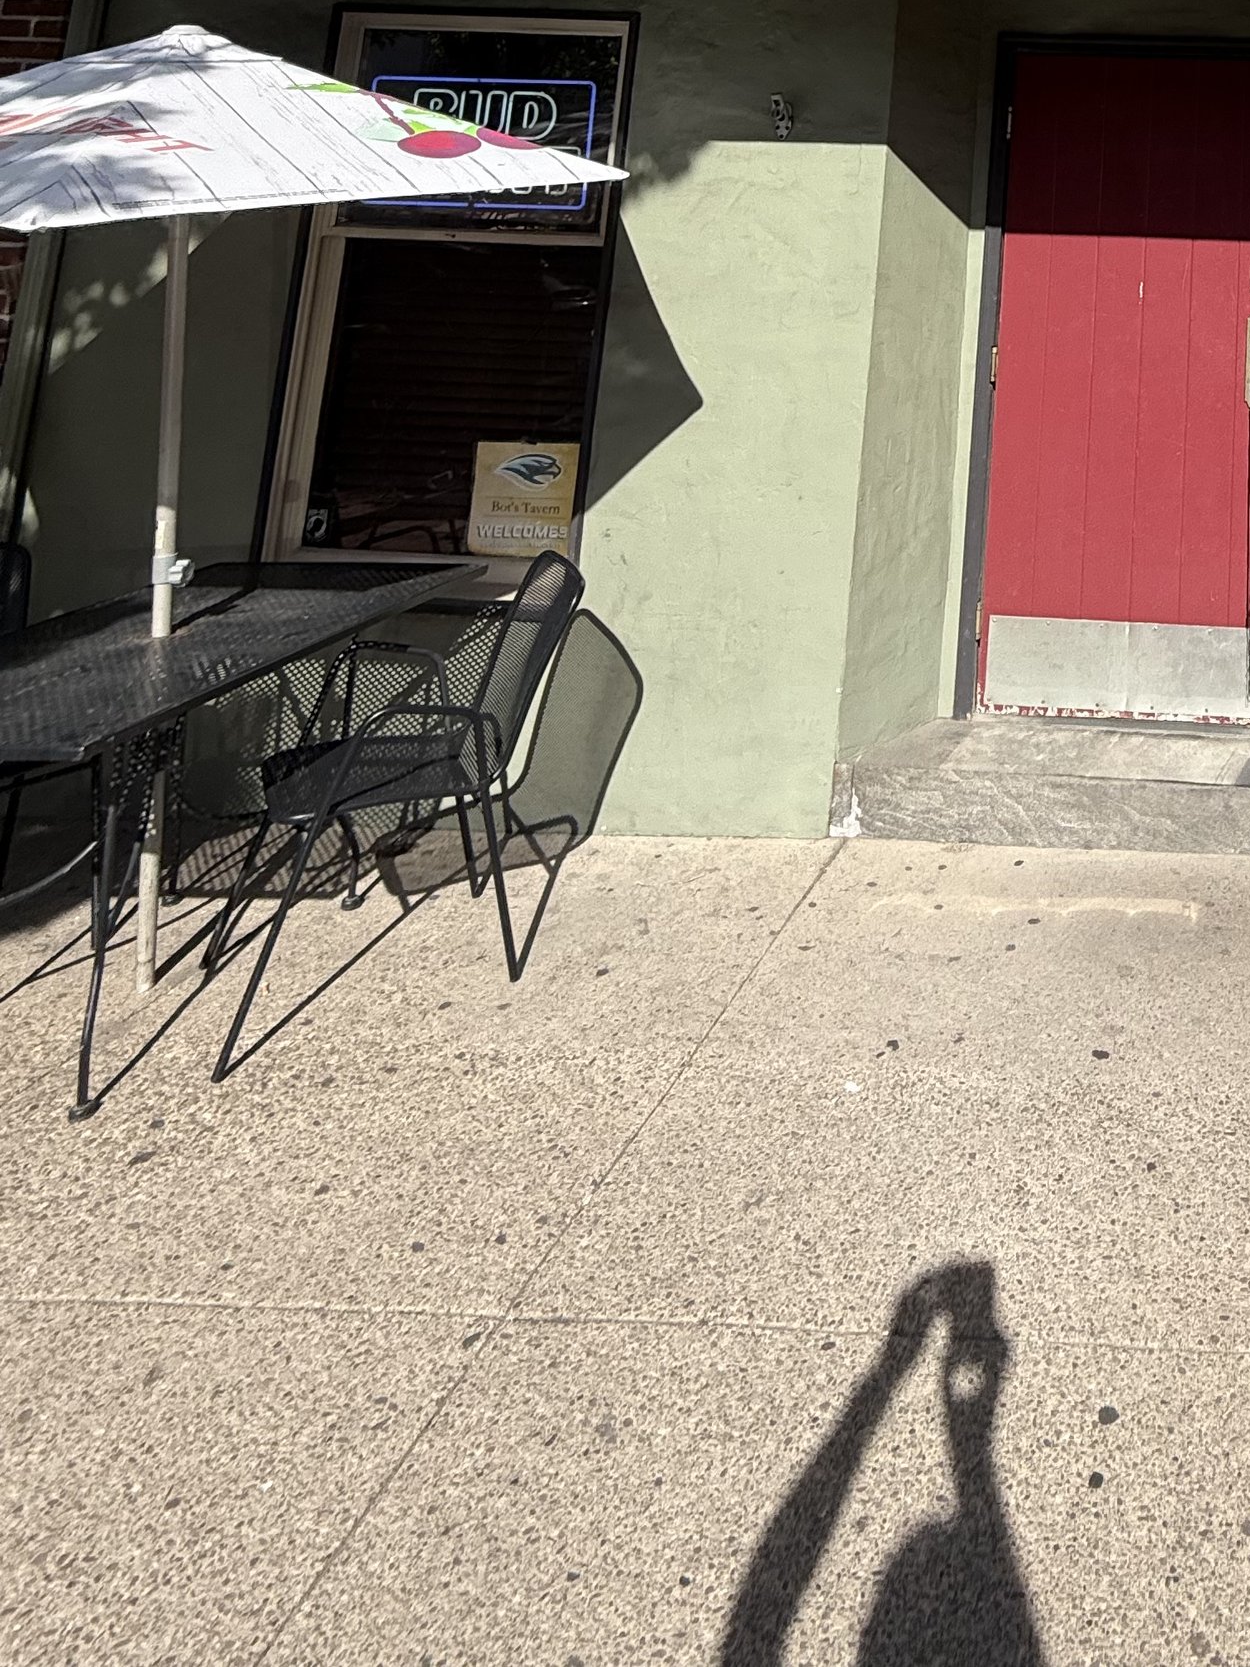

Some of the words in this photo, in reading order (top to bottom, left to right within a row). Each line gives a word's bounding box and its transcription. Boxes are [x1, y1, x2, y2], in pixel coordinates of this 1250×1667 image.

[491, 500, 519, 513] Bot's
[521, 502, 561, 515] Tavern
[477, 524, 569, 540] WELCOMES
